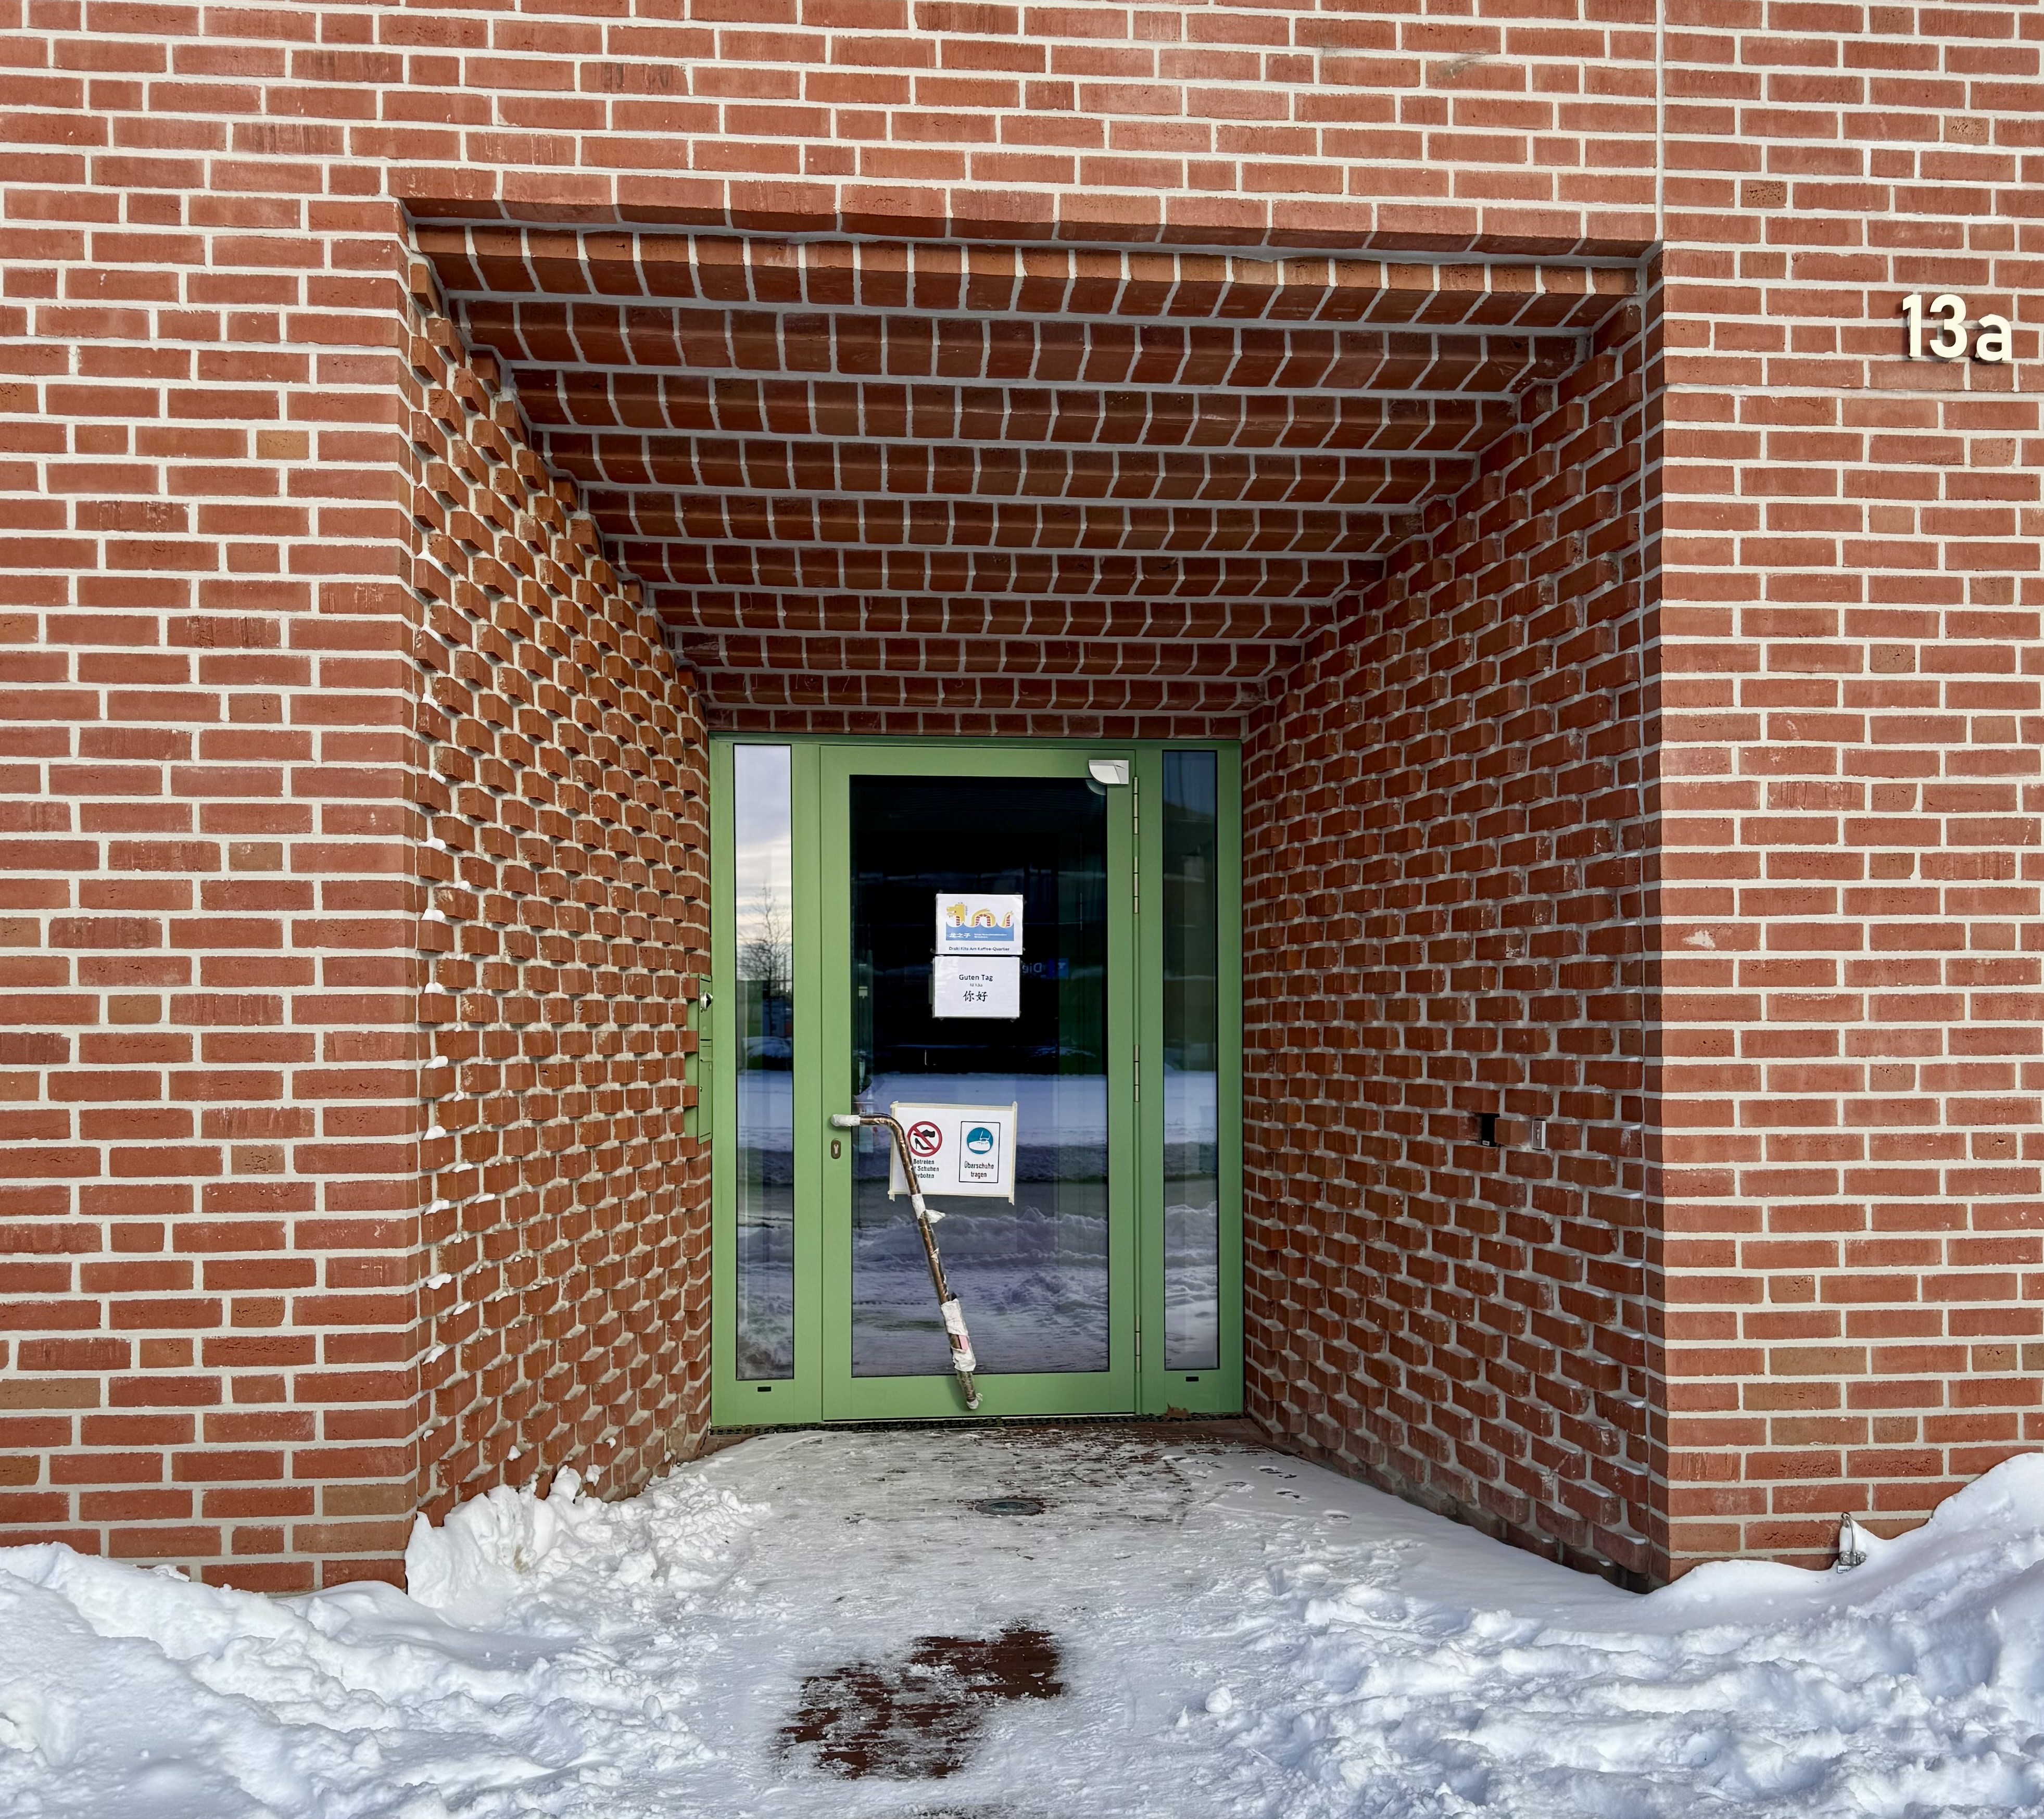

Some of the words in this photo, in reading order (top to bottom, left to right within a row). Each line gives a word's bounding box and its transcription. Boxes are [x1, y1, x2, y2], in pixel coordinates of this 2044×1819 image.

[1902, 294, 2013, 362] 13a
[963, 990, 988, 1002] 你好
[964, 1160, 994, 1169] Überschuhe
